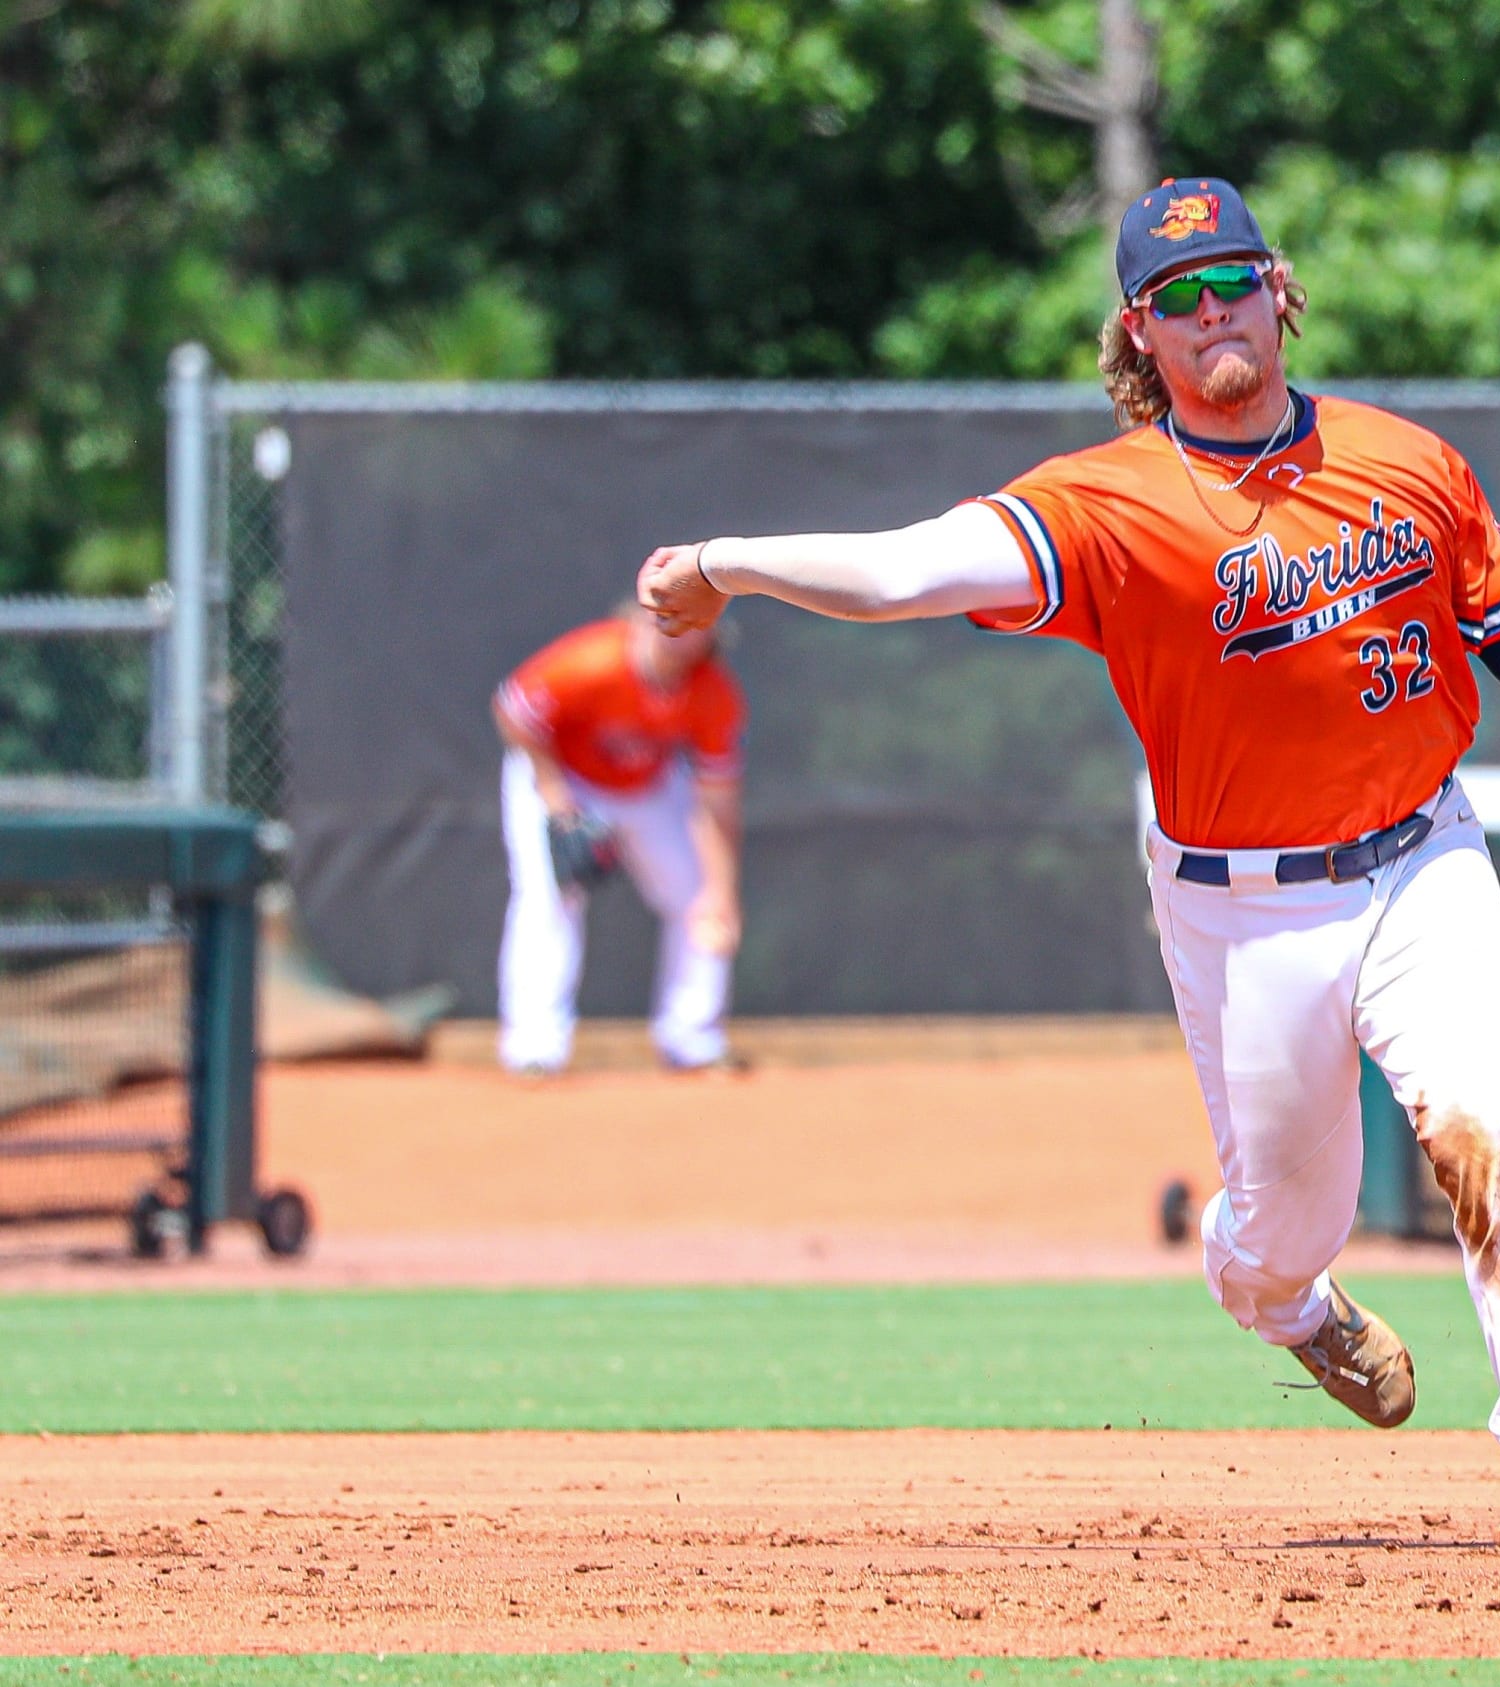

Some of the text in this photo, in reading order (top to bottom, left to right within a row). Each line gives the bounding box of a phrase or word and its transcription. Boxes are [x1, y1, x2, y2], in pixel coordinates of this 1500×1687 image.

[1213, 496, 1435, 634] Florida
[1293, 588, 1376, 642] BURN
[1359, 620, 1435, 714] 32
